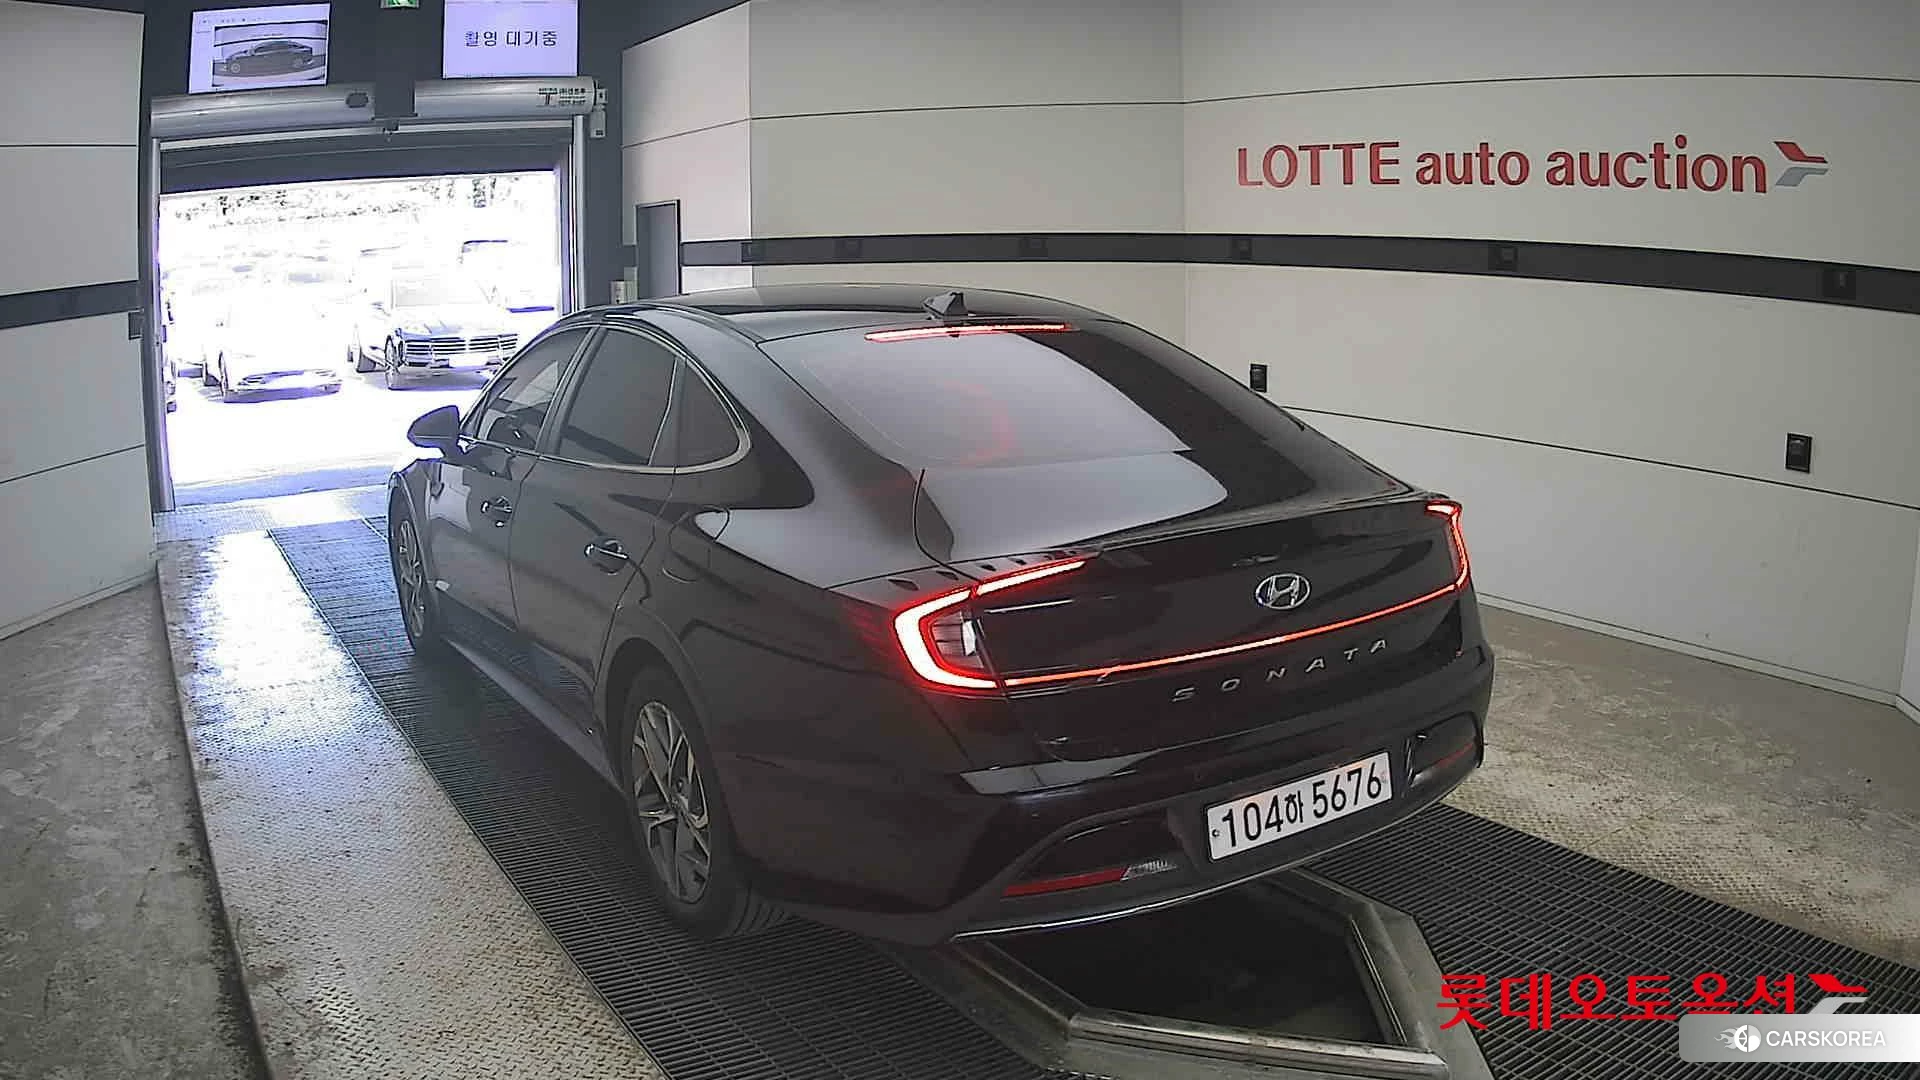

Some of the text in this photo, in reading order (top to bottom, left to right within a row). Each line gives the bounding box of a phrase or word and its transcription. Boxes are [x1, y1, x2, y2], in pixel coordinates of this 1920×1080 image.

[506, 31, 557, 47] 대기중
[1238, 134, 1768, 193] LOTTE auto auction
[1172, 639, 1387, 702] SONATA
[1312, 762, 1382, 818] 5676
